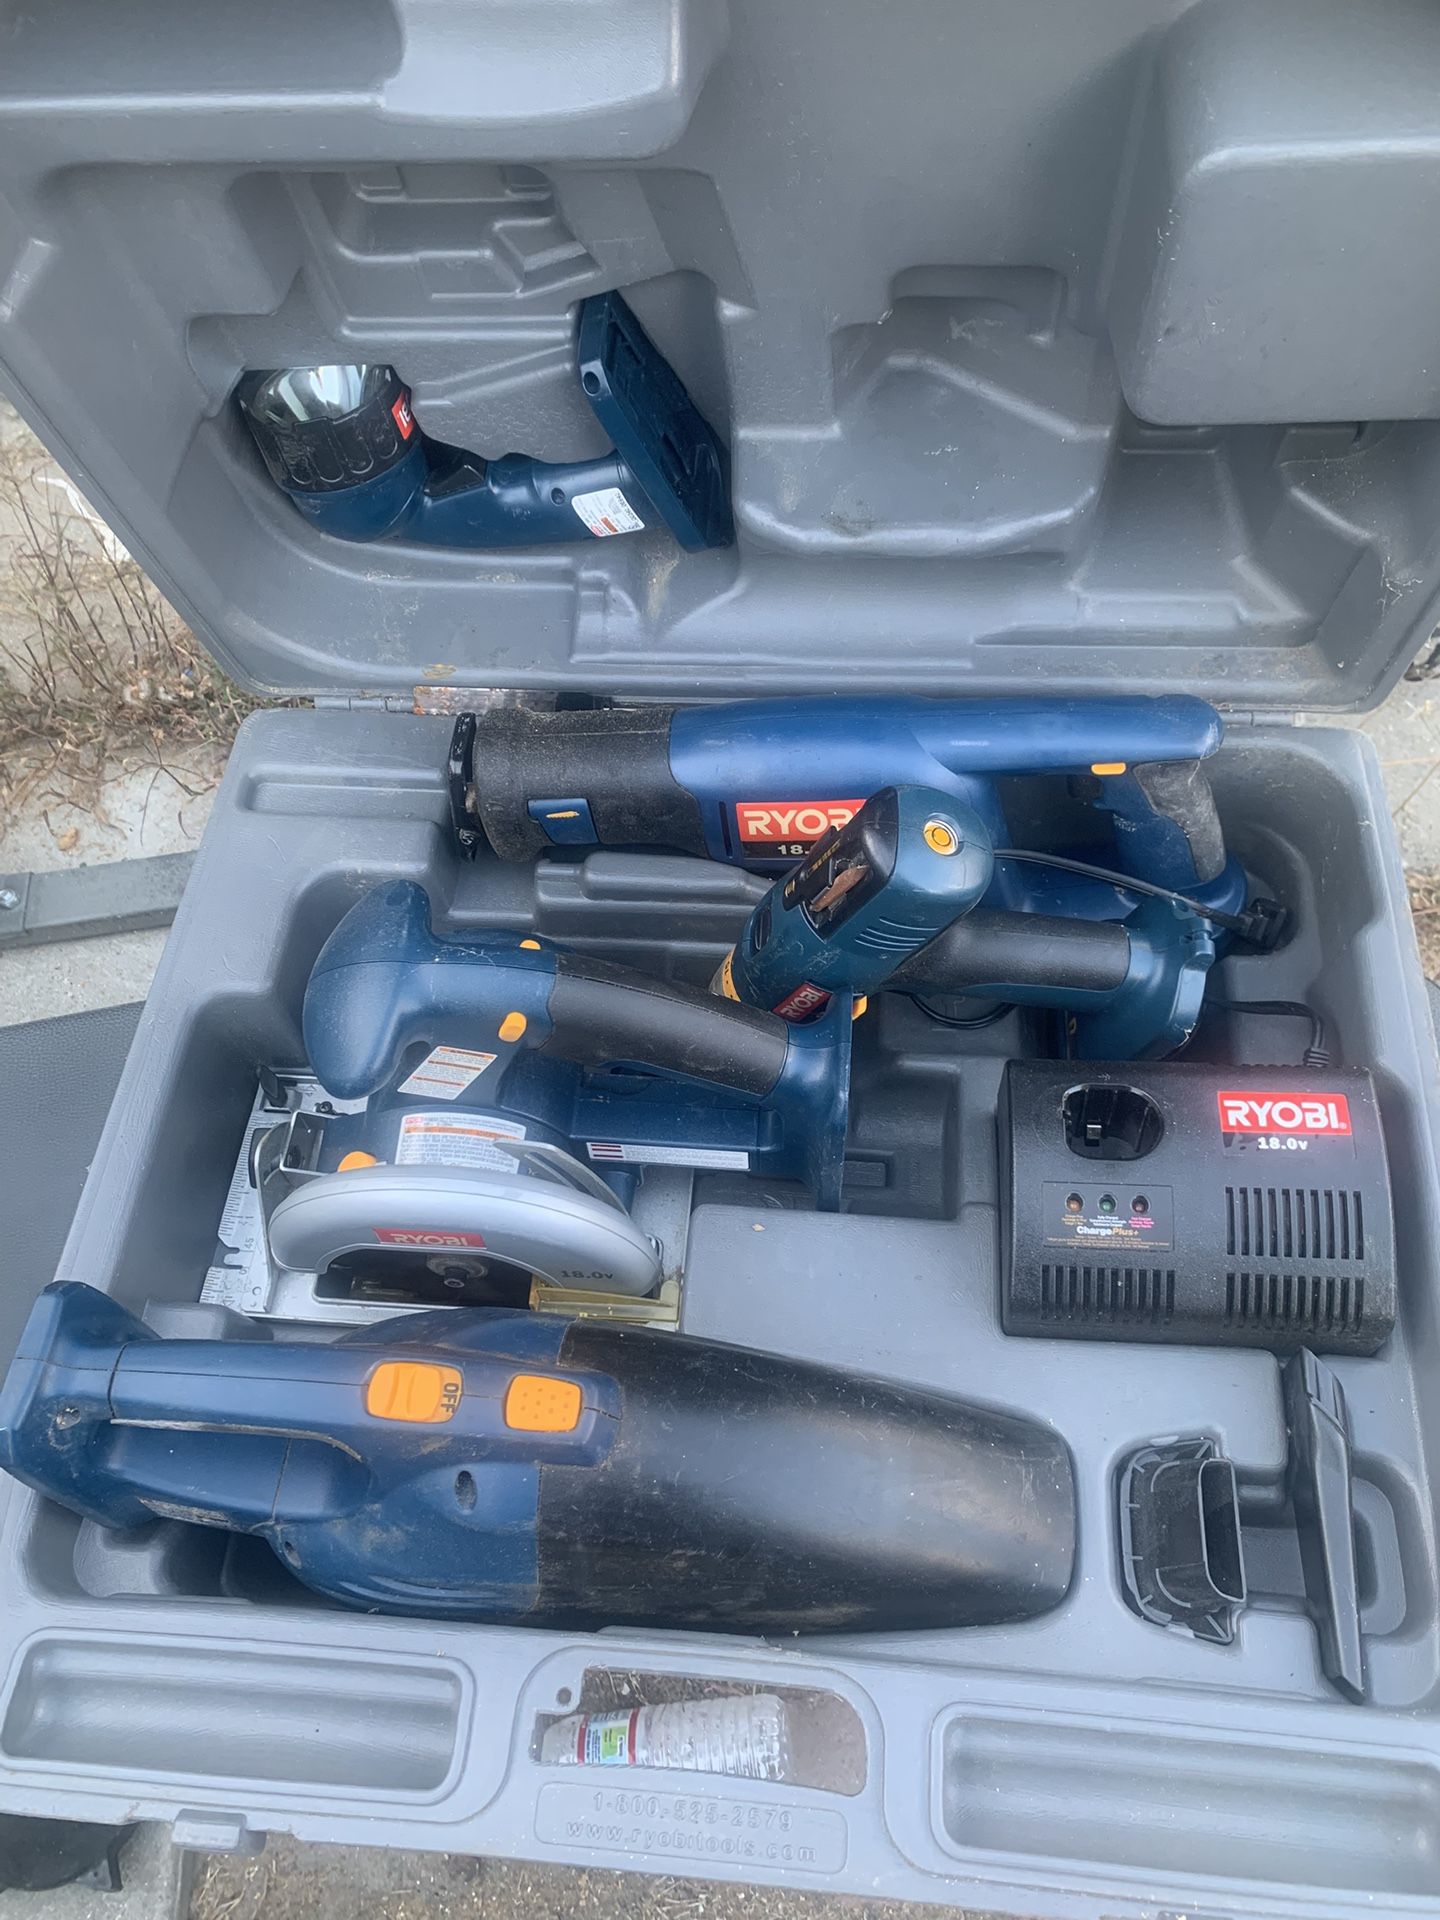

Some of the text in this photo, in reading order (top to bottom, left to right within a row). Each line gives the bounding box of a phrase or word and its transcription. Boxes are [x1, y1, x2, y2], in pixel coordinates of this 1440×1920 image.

[744, 808, 861, 835] RYOB
[780, 988, 823, 1017] RYOBI
[1223, 1100, 1339, 1128] RYOBI
[1258, 1136, 1308, 1150] 18.0v
[390, 1233, 468, 1246] RYOBI
[561, 1270, 614, 1280] 18.0v
[440, 1382, 460, 1414] OFF
